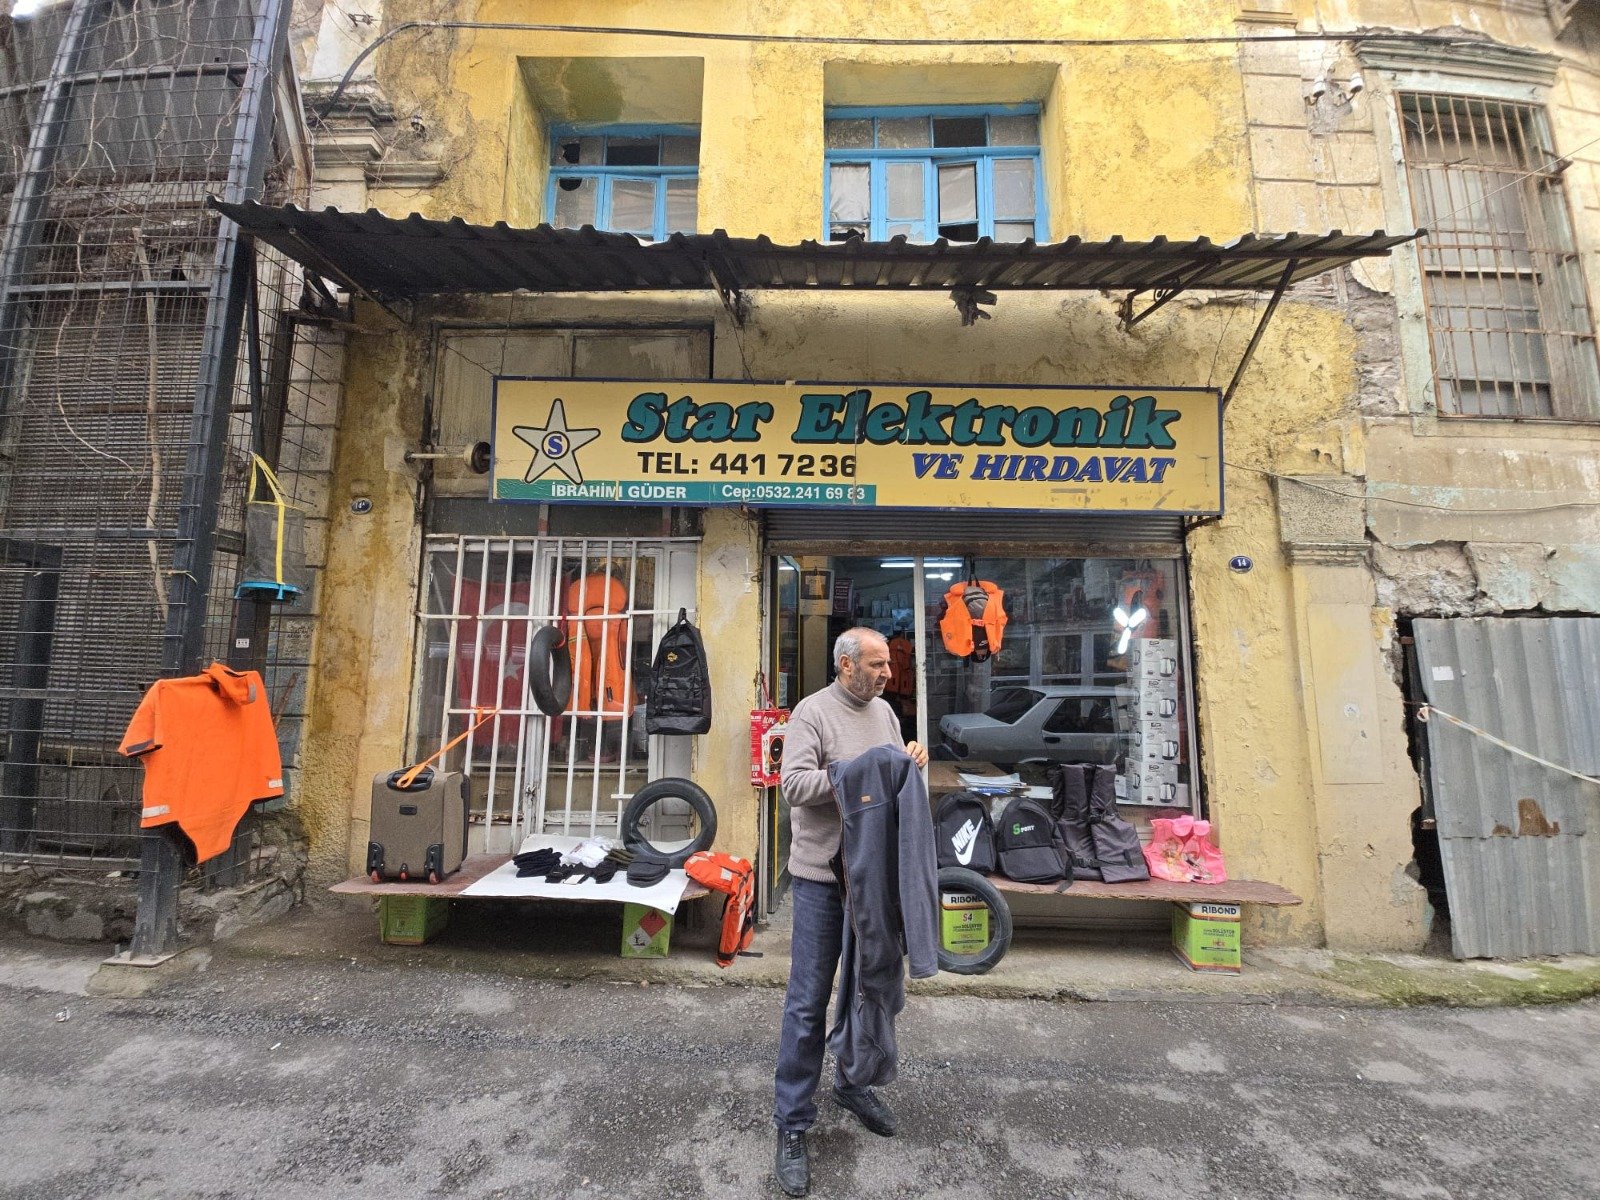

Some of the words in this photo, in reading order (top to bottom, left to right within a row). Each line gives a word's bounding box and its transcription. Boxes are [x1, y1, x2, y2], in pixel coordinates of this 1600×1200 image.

[621, 391, 775, 443] Star
[790, 389, 1182, 450] Elektronik
[547, 435, 563, 456] S
[637, 451, 699, 475] TEL:
[709, 452, 767, 476] 441
[777, 453, 857, 478] 7236
[911, 452, 965, 481] VE
[969, 453, 1177, 484] HIRDAVAT
[627, 482, 687, 499] GÜDER
[825, 486, 843, 500] 69
[1236, 558, 1248, 567] 14
[951, 818, 976, 853] NIKE
[1201, 905, 1237, 915] RIBOND
